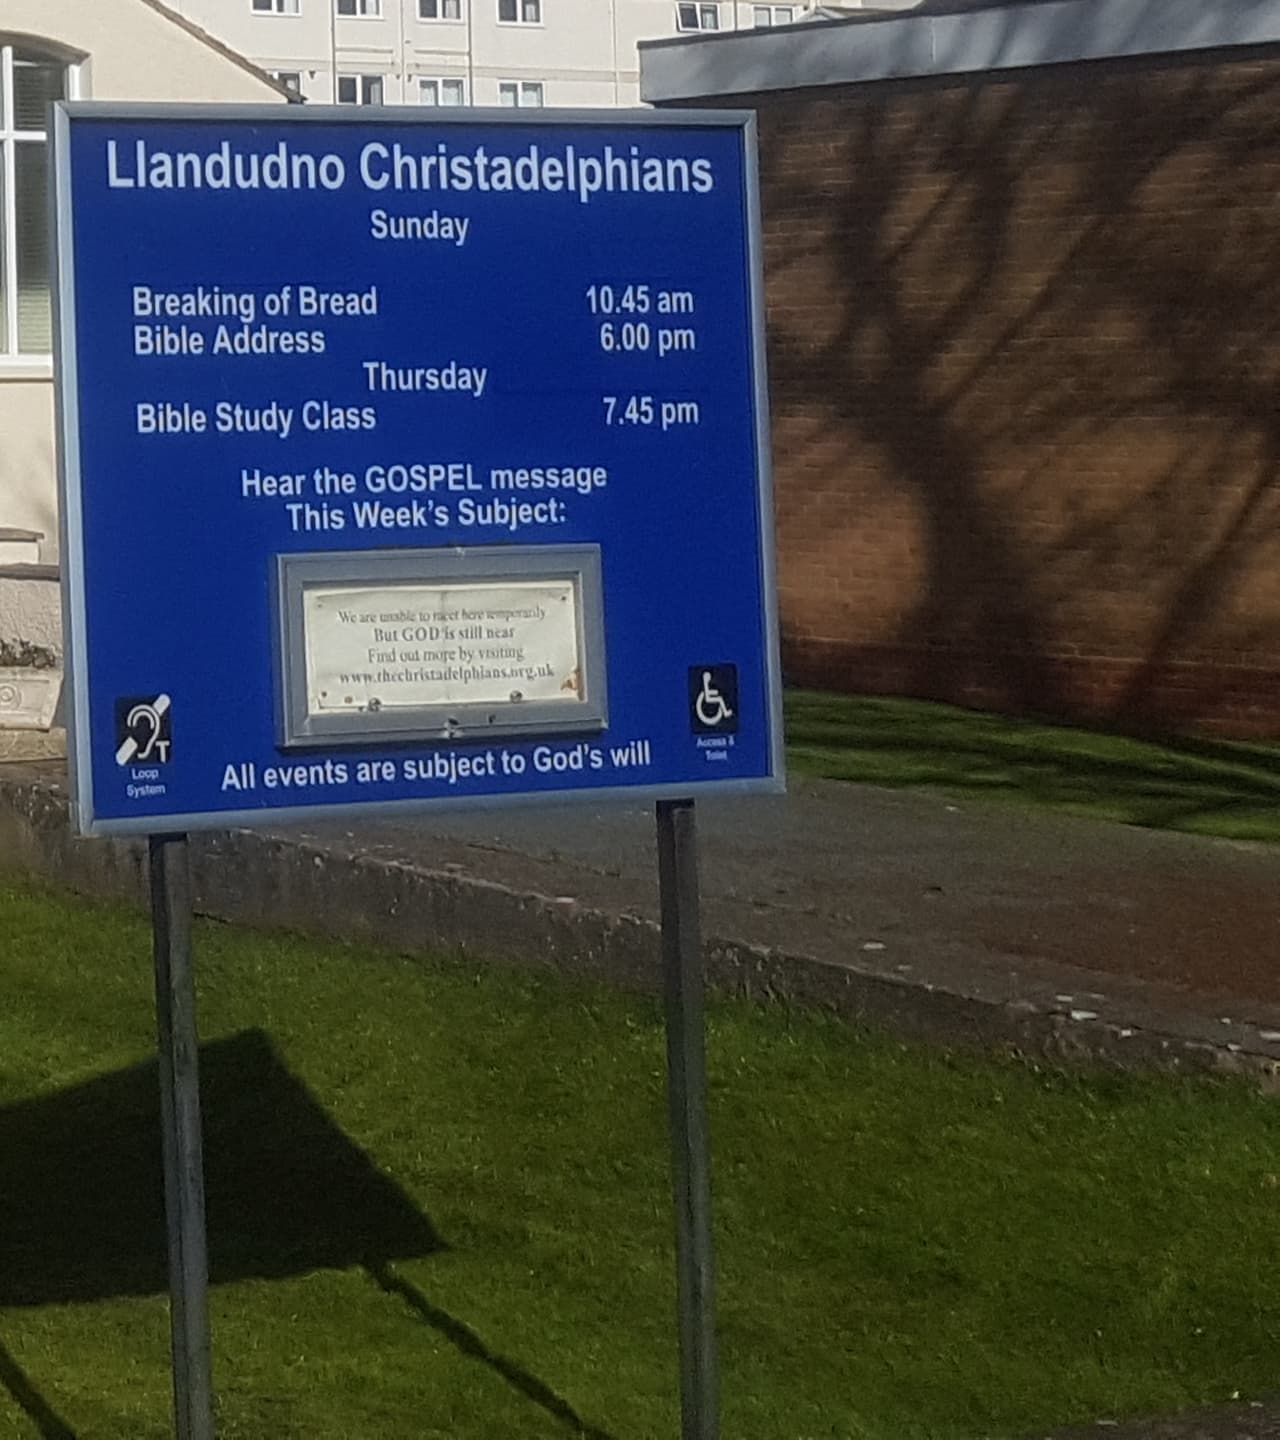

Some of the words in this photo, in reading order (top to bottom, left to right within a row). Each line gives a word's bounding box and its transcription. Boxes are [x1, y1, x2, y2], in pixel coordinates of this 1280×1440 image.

[108, 140, 344, 189] Llandudno
[361, 143, 712, 202] Christadelphians
[372, 210, 468, 245] Sunday
[134, 287, 254, 323] Breaking
[264, 287, 290, 315] of
[300, 287, 376, 315] Bread
[587, 286, 649, 313] 10.45
[659, 293, 693, 312] am
[135, 326, 203, 354] Bible
[213, 325, 324, 354] Address
[601, 323, 649, 350] 6.00
[659, 330, 694, 356] pm
[364, 362, 486, 396] Thursday
[138, 403, 206, 432] Bible
[216, 402, 292, 438] Study
[303, 401, 375, 430] Class
[604, 397, 652, 424] 7.45
[662, 403, 698, 430] pm
[243, 470, 305, 496] Hear
[314, 468, 356, 494] the
[366, 464, 482, 492] GOSPEL
[491, 468, 606, 493] message
[286, 503, 344, 530] This
[353, 500, 449, 528] Week’s
[459, 498, 564, 530] Subject:
[338, 611, 356, 623] We
[360, 614, 376, 623] are
[419, 612, 430, 621] to
[374, 628, 398, 642] But
[402, 627, 439, 641] GOD
[444, 627, 455, 639] is
[459, 626, 482, 638] still
[487, 628, 515, 639] near
[368, 648, 395, 663] Find
[400, 650, 419, 661] out
[424, 650, 455, 660] more
[459, 646, 474, 663] by
[478, 647, 524, 661] visiting
[130, 767, 160, 781] Loop
[222, 763, 254, 790] All
[264, 760, 347, 787] events
[357, 762, 395, 782] are
[404, 752, 494, 783] subject
[502, 751, 525, 774] to
[534, 744, 602, 771] God’s
[611, 741, 649, 766] will
[126, 783, 166, 799] System
